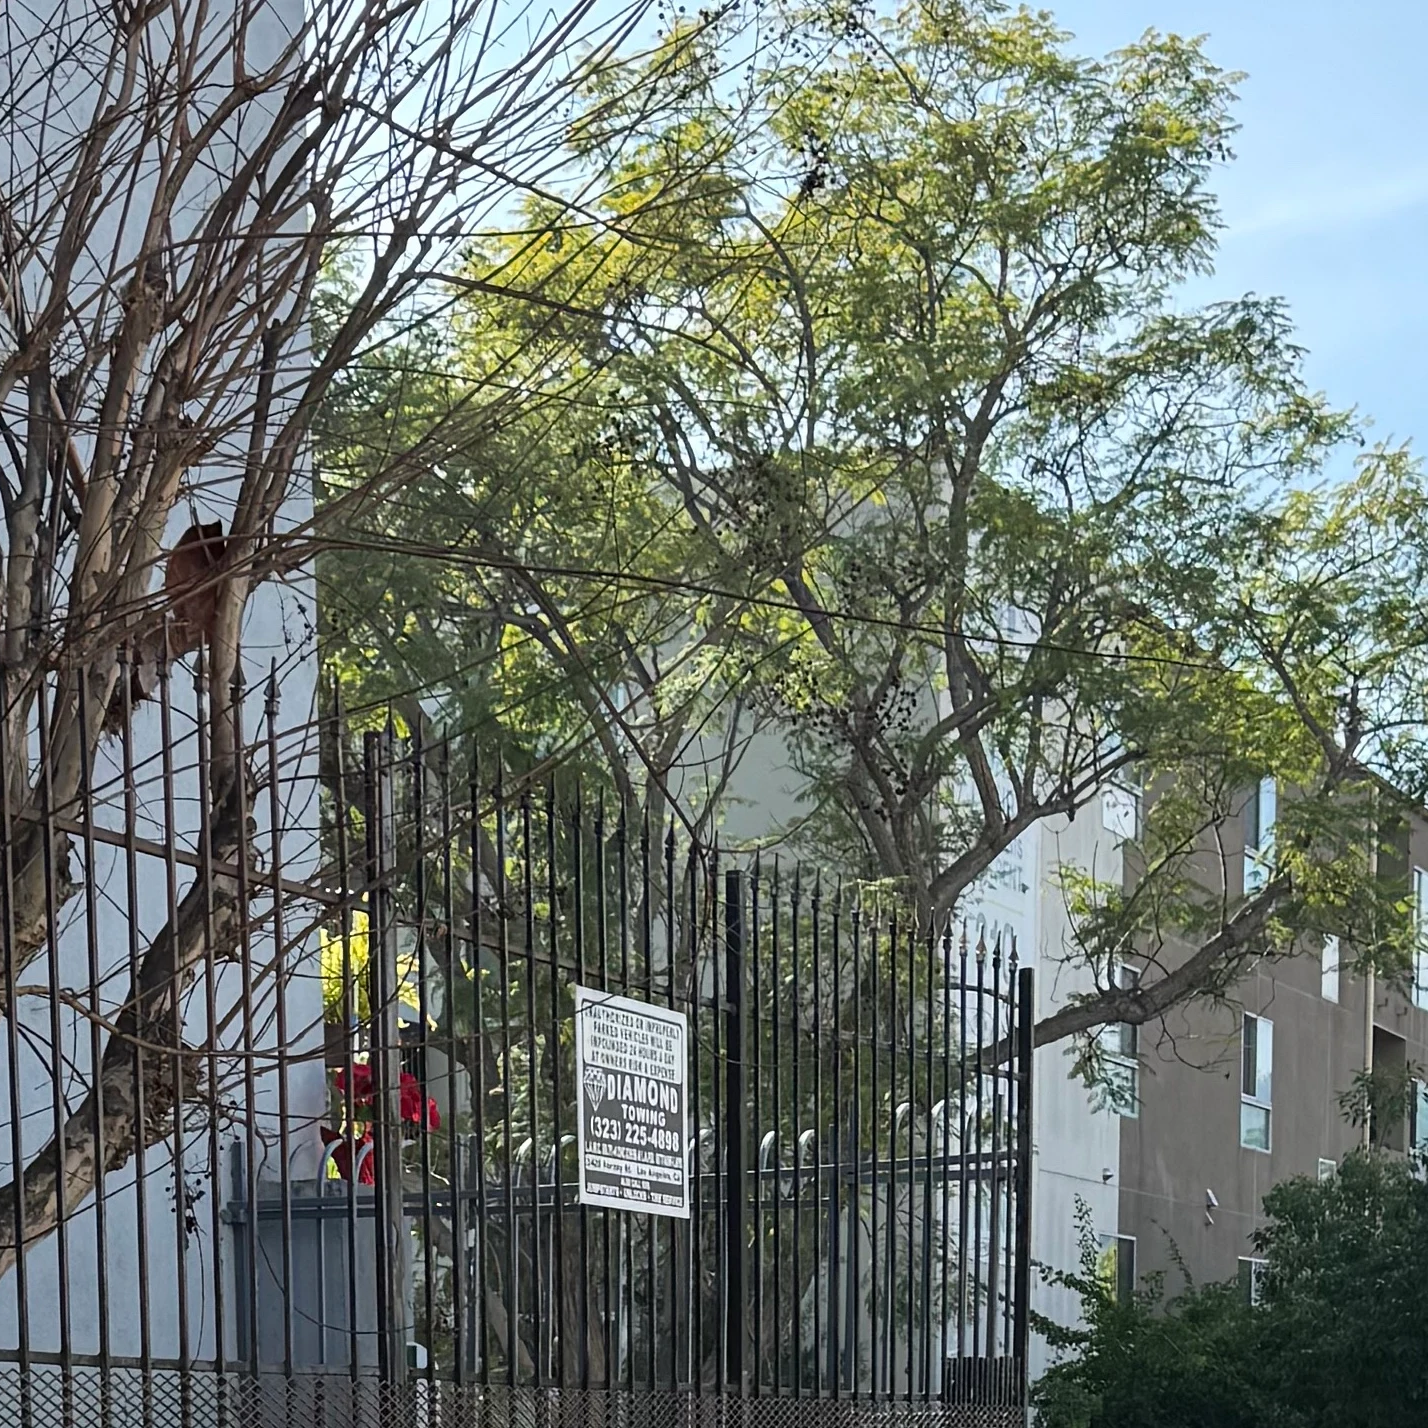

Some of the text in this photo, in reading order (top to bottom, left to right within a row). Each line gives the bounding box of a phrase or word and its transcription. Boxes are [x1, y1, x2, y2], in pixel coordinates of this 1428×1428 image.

[594, 1021, 617, 1037] PARKED
[620, 1028, 648, 1045] VEHICLES
[607, 1074, 678, 1113] DIAMOND
[621, 1104, 665, 1127] TOWING
[590, 1116, 679, 1152] (323) 225-4898
